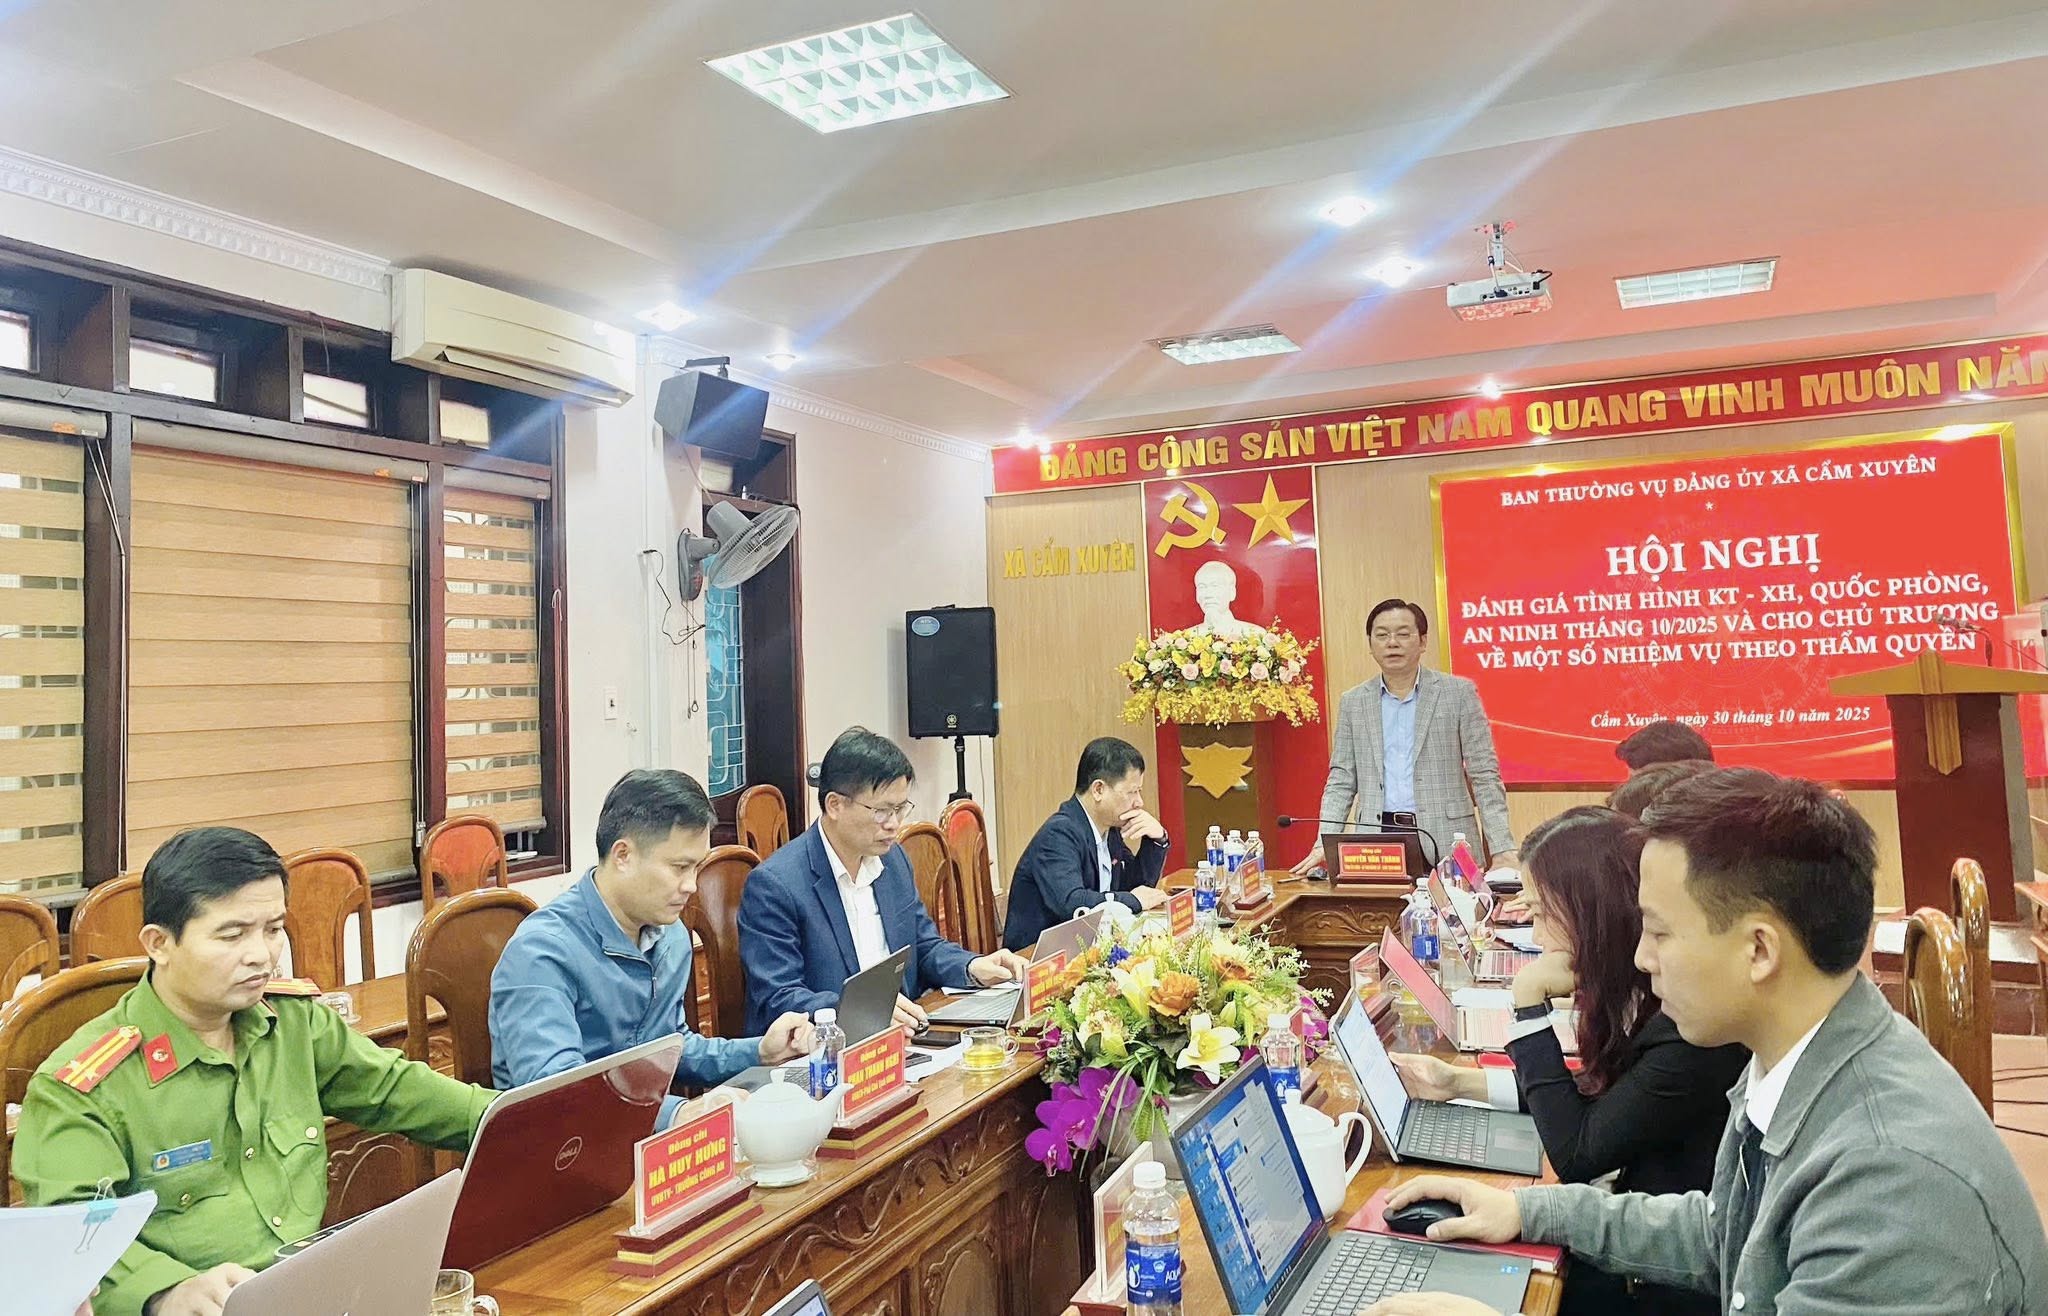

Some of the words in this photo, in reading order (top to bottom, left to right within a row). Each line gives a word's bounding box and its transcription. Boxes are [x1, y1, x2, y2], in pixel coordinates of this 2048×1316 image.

[1040, 443, 1127, 482] ĐẢNG
[1138, 435, 1229, 476] CỘNG
[1239, 420, 1315, 461] SẢN
[1325, 414, 1405, 456] VIỆT
[1418, 406, 1513, 445] NAM
[1526, 389, 1667, 436] QUANG
[1680, 378, 1784, 418] VINH
[1800, 358, 1941, 407] MUÔN
[1501, 489, 1539, 507] BAN
[1545, 480, 1634, 503] THƯỜNG
[1639, 479, 1667, 498] VỤ
[1674, 472, 1730, 493] ĐẢNG
[1737, 468, 1765, 487] ỦY
[1771, 465, 1800, 484] XÃ
[1805, 459, 1853, 481] CẨM
[1859, 453, 1937, 477] XUYÊN
[1003, 546, 1027, 579] XÃ
[1076, 538, 1135, 574] XUYÊN
[1605, 533, 1687, 582] HỘI
[1701, 533, 1821, 573] NGHỊ
[1461, 595, 1524, 618] ĐÁNH
[1529, 592, 1570, 615] GIÁ
[1573, 590, 1632, 613] TÌNH
[1639, 587, 1701, 609] HÌNH
[1708, 587, 1739, 605] KT
[1760, 584, 1803, 605] XH,
[1810, 572, 1881, 602] QUỐC
[1887, 571, 1989, 596] PHÒNG,
[1462, 627, 1493, 644] AN
[1498, 623, 1557, 643] NINH
[1563, 617, 1643, 640] THÁNG
[1651, 615, 1718, 636] 10/2025
[1723, 609, 1755, 633] VÀ
[1761, 609, 1813, 631] CHO
[1819, 603, 1873, 627] CHỦ
[1880, 601, 1999, 625] TRƯƠNG
[1477, 645, 1507, 669] VỀ
[1512, 646, 1562, 672] MỘT
[1567, 641, 1597, 667] SỐ
[1602, 640, 1683, 668] NHIỆM
[1688, 642, 1722, 665] VỤ
[1731, 639, 1796, 660] THEO
[1802, 630, 1878, 657] THẨM
[1885, 624, 1976, 658] QUYỀN
[1712, 710, 1730, 725] 30
[1733, 708, 1772, 726] tháng
[1778, 709, 1795, 723] 10
[1799, 709, 1830, 722] năm
[1836, 706, 1870, 722] 2025
[648, 1165, 666, 1189] HÀ
[668, 1152, 693, 1179] HUY
